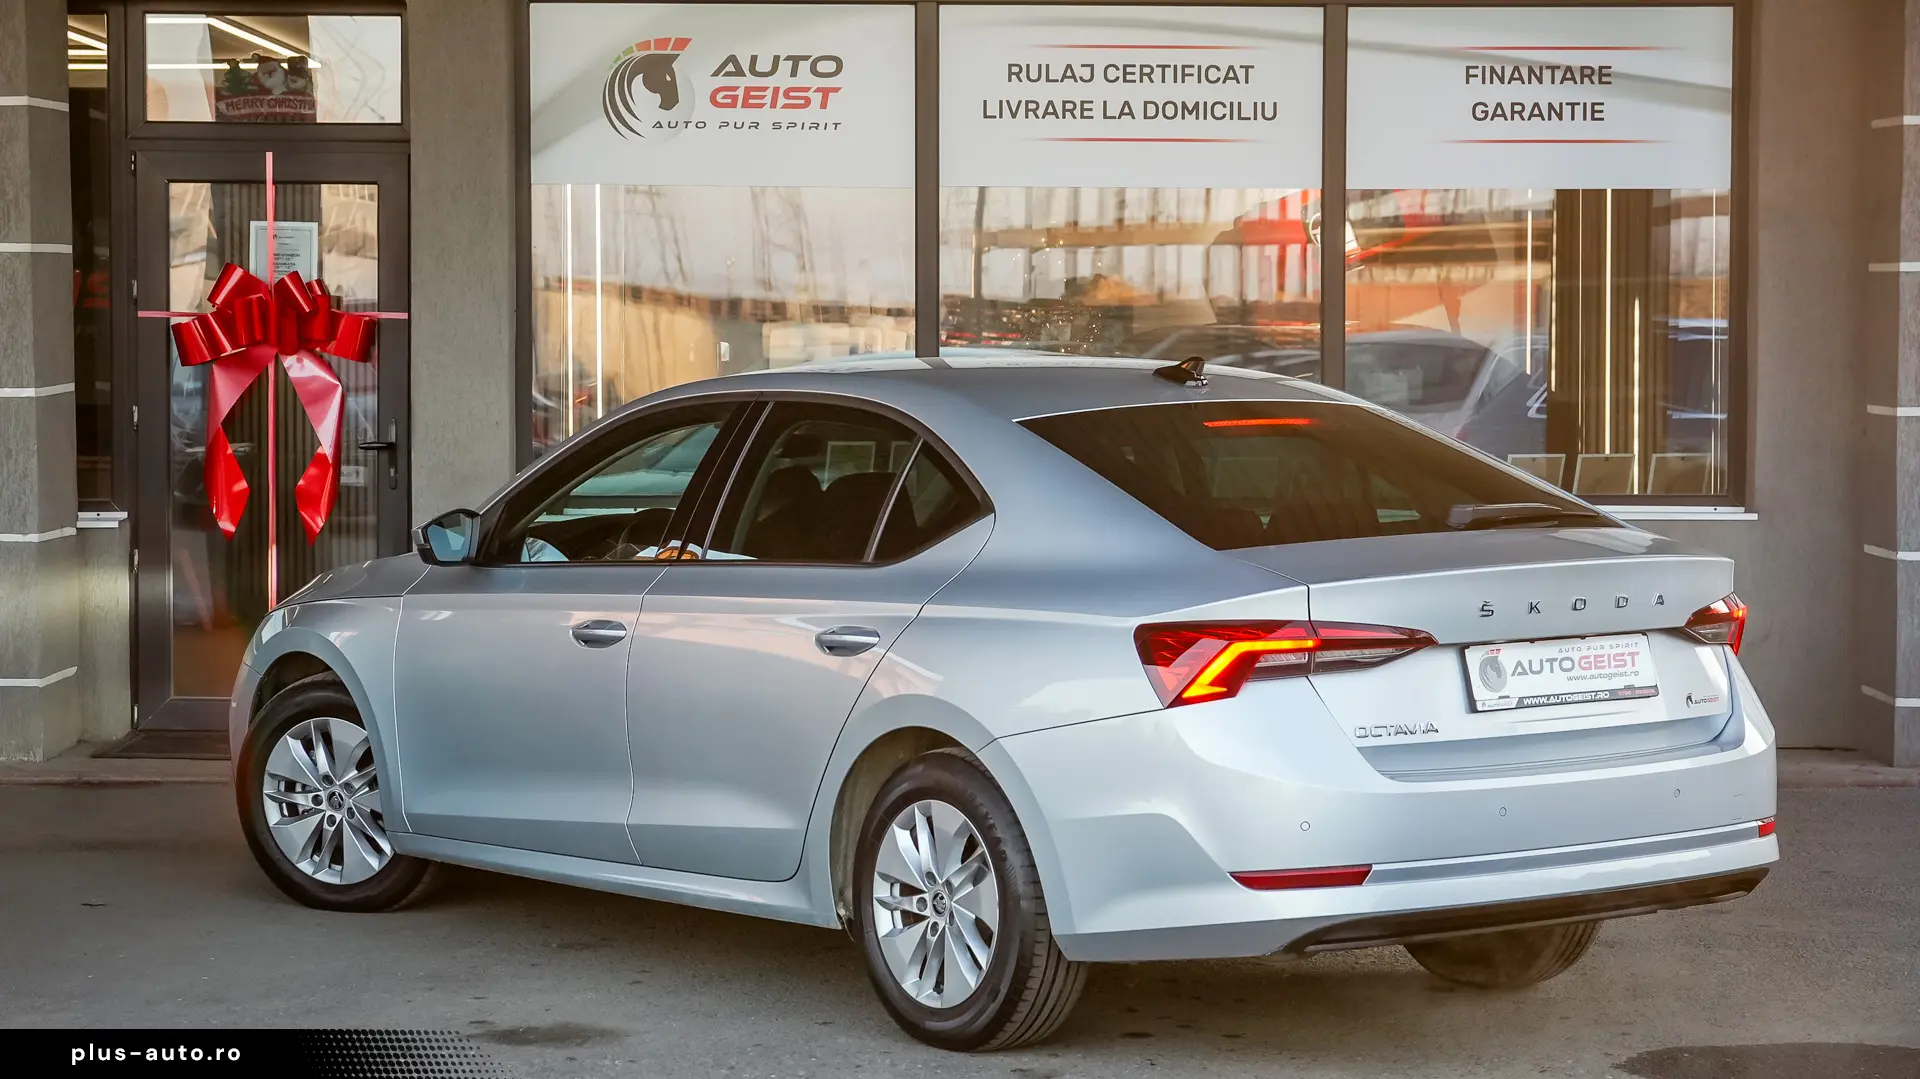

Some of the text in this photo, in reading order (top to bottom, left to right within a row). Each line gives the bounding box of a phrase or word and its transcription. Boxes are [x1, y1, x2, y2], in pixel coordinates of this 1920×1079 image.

[711, 54, 843, 78] AUTO
[1007, 63, 1255, 85] RULAJ CERTIFICAT
[1465, 65, 1613, 85] FINANTARE
[224, 97, 264, 112] MERRY
[710, 86, 842, 110] GEIST
[982, 99, 1278, 121] LIVRARE LA DOMICILIU
[1471, 101, 1605, 122] GARANTIE
[652, 120, 842, 131] AUTO PUR SPIRIT
[1479, 593, 1665, 618] ŠKODA
[1557, 646, 1582, 654] AUTO
[1609, 642, 1639, 650] SPIRIT
[1566, 670, 1640, 681] www.autogeist.ro
[1523, 690, 1610, 705] WWW.AUTOGEIST.RO
[1355, 721, 1439, 738] OCTAVIA
